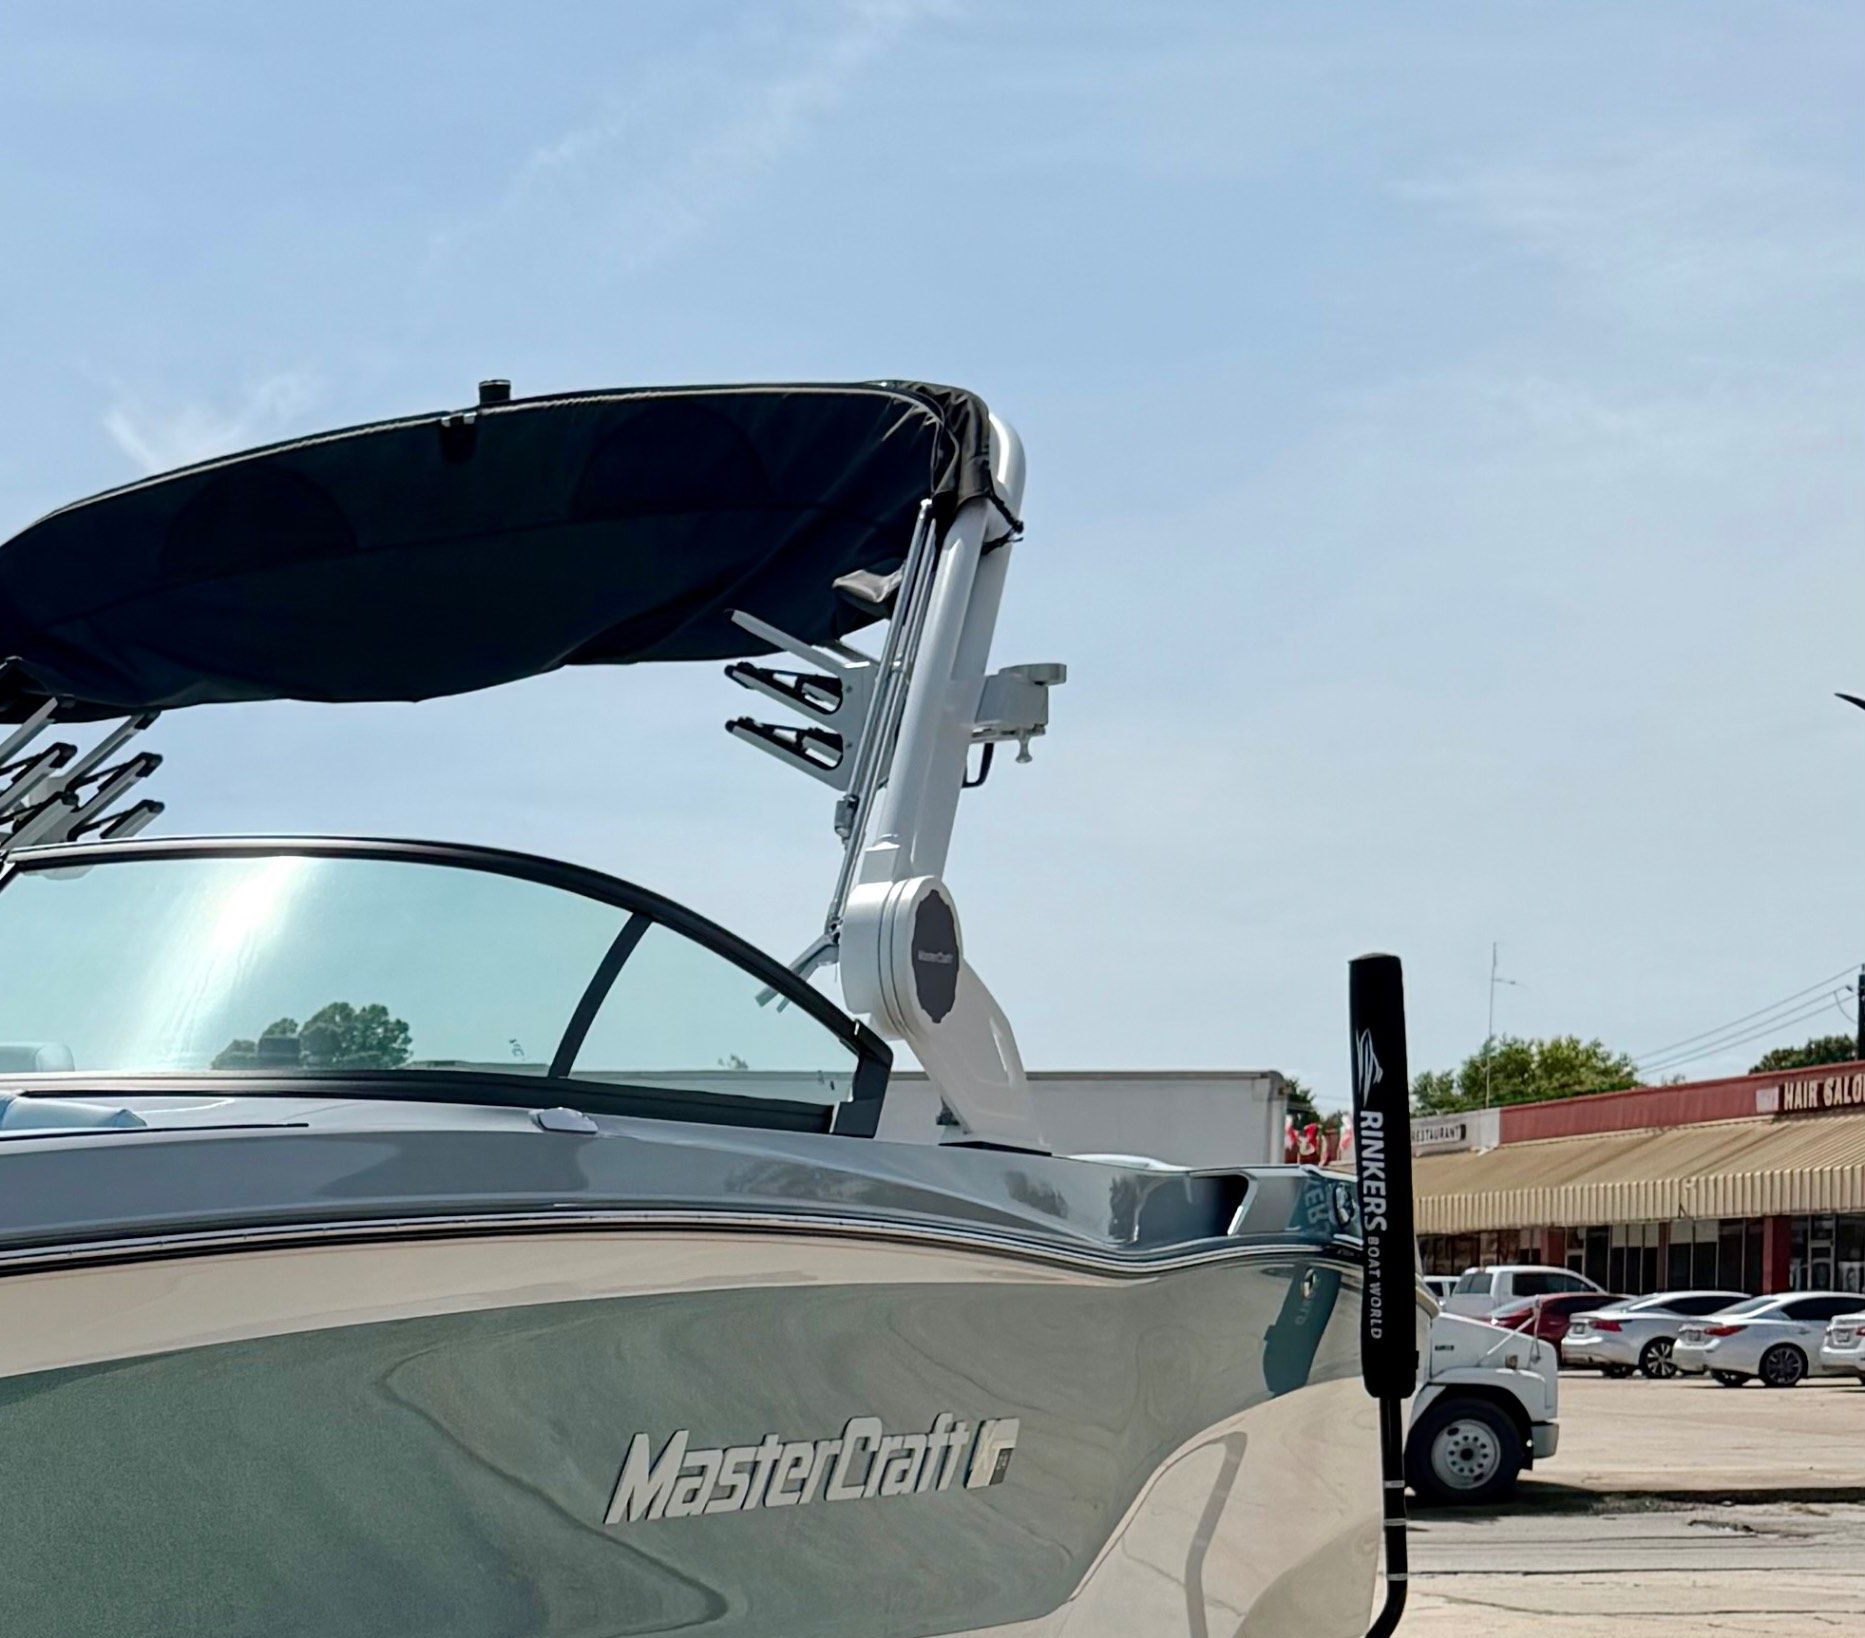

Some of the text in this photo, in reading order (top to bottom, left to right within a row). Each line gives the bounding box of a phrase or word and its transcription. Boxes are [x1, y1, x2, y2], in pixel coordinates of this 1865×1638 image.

[1784, 1073, 1865, 1111] HAIR SALO
[1360, 1110, 1387, 1339] RINKERS BOAT WORLD
[603, 1411, 970, 1525] MasterCraft
